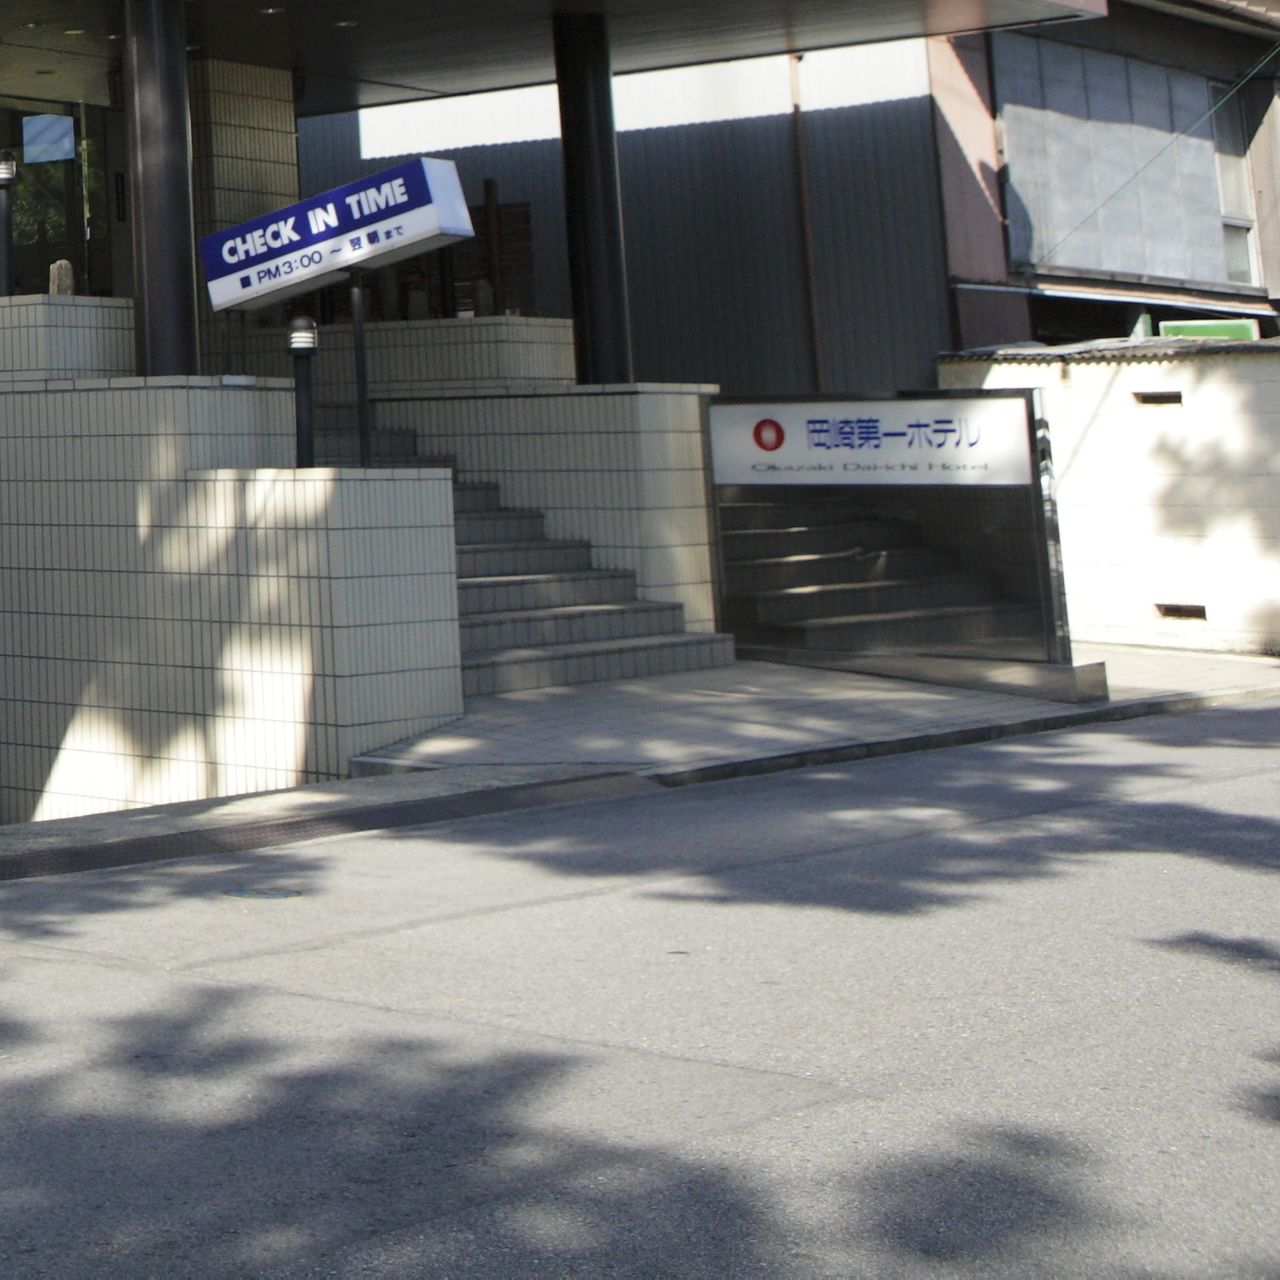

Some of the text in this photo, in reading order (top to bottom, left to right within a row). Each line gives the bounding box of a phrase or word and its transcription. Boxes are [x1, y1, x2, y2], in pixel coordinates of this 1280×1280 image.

[221, 177, 409, 264] CHECK IN TIME
[806, 417, 981, 450] 岡崎第一ホテル
[751, 462, 834, 472] Okazaki
[928, 461, 989, 472] Hotel
